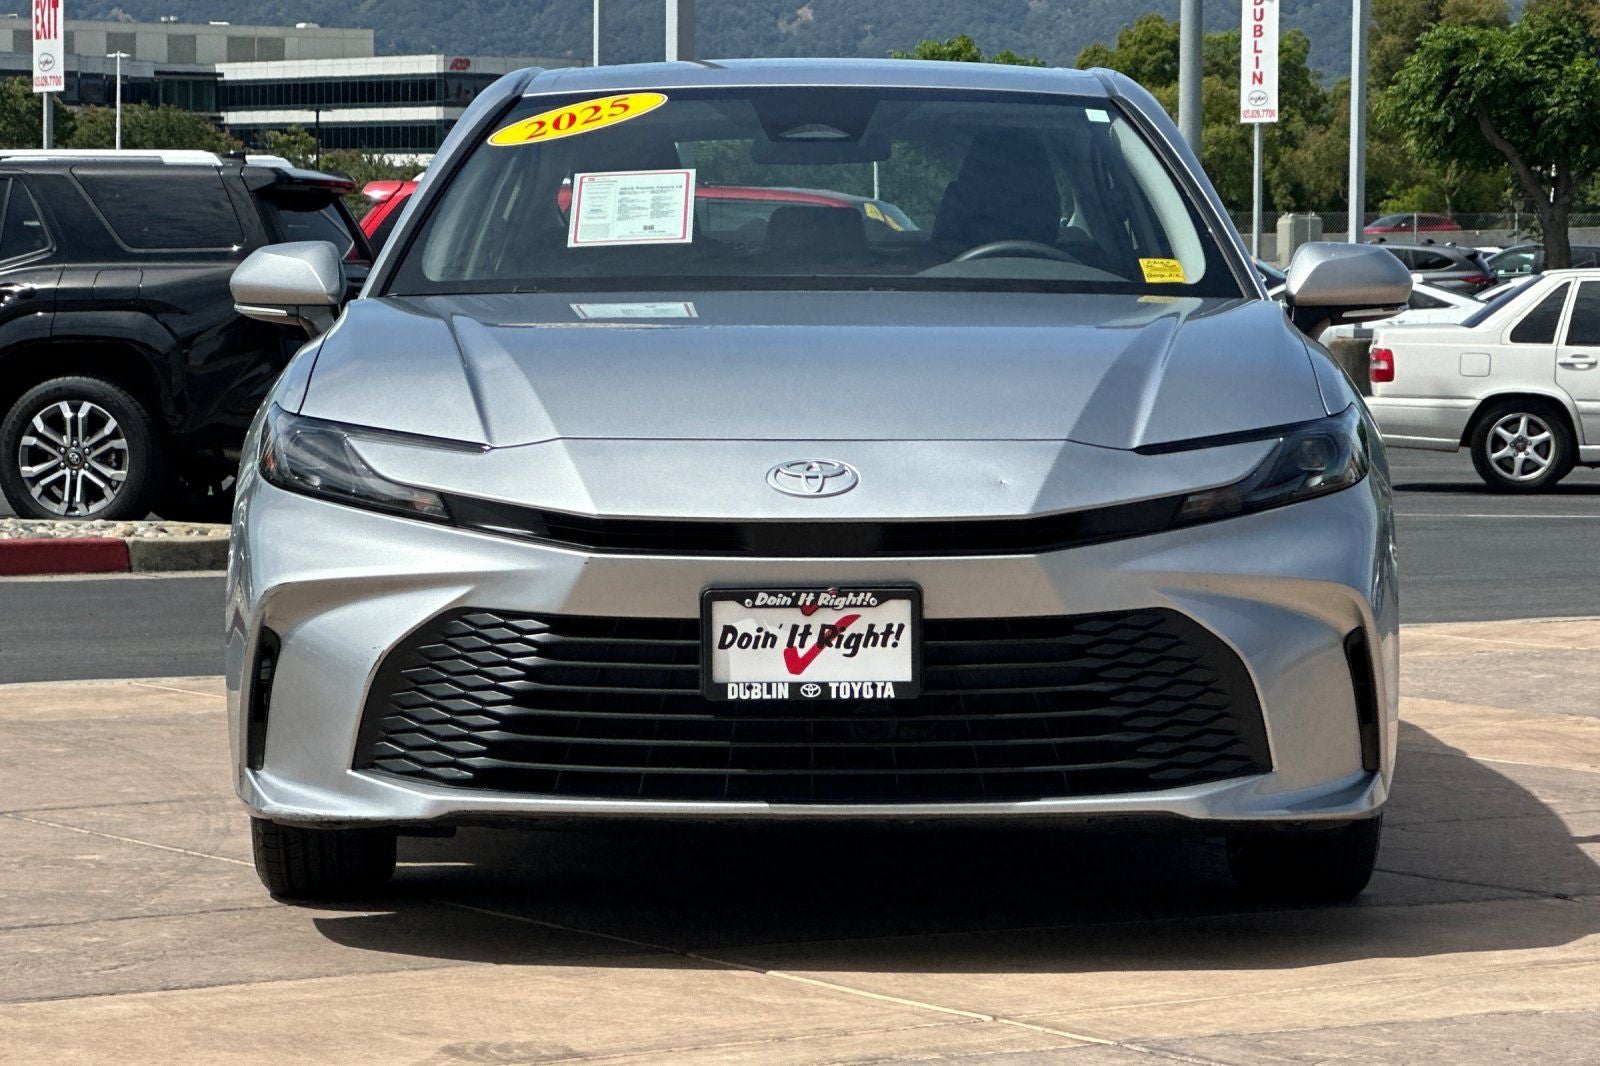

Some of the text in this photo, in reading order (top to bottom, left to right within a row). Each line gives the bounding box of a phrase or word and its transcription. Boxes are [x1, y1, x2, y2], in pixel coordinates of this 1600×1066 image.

[35, 0, 59, 40] EXIT
[525, 97, 630, 140] 2025
[754, 592, 871, 610] Doin' It Right!
[718, 622, 906, 658] Doin' It Right!
[727, 681, 895, 700] DUBLIN TOYOTA
